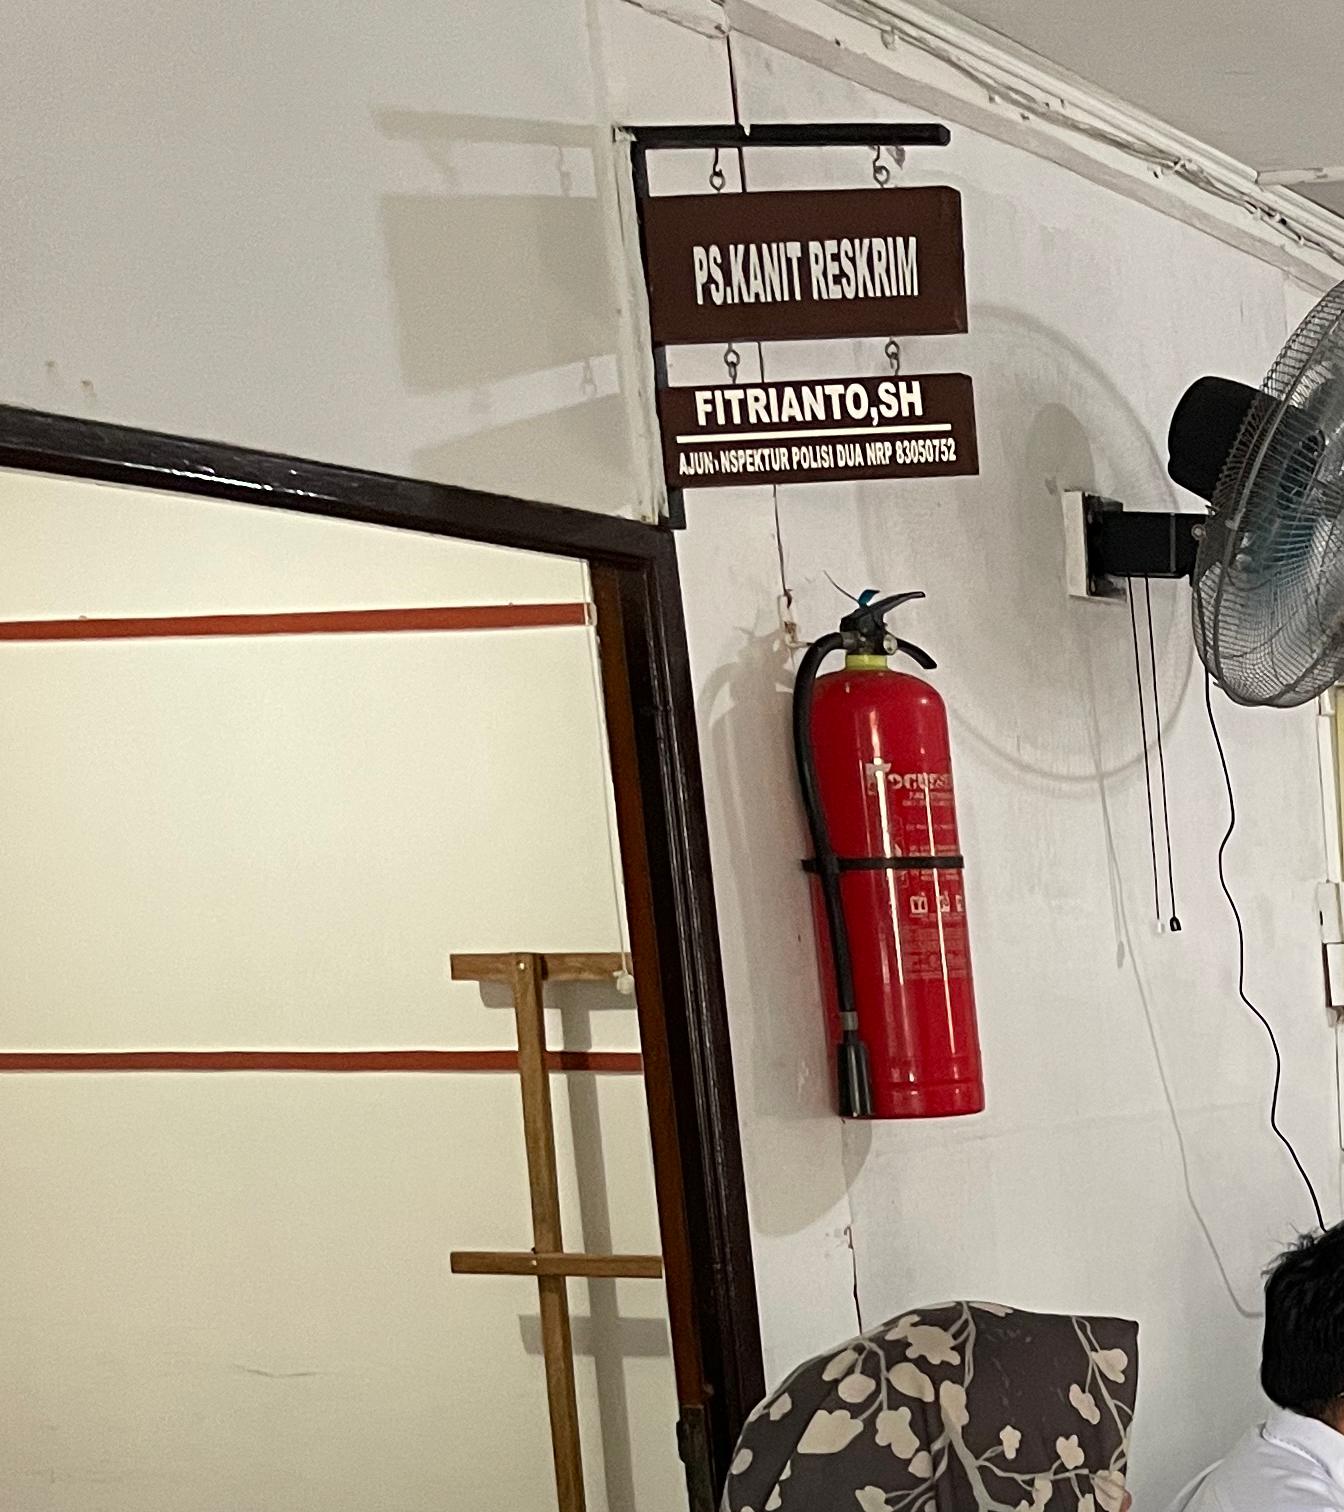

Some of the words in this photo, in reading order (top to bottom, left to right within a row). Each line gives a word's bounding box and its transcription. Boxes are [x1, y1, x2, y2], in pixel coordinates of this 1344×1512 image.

[692, 241, 802, 306] PS.KANIT
[809, 236, 919, 300] RESKRIM
[694, 380, 924, 426] FITRIANTO,SH
[791, 444, 835, 470] POLISI
[836, 443, 865, 468] DUA
[866, 441, 893, 466] NRP
[895, 437, 957, 465] 83050752
